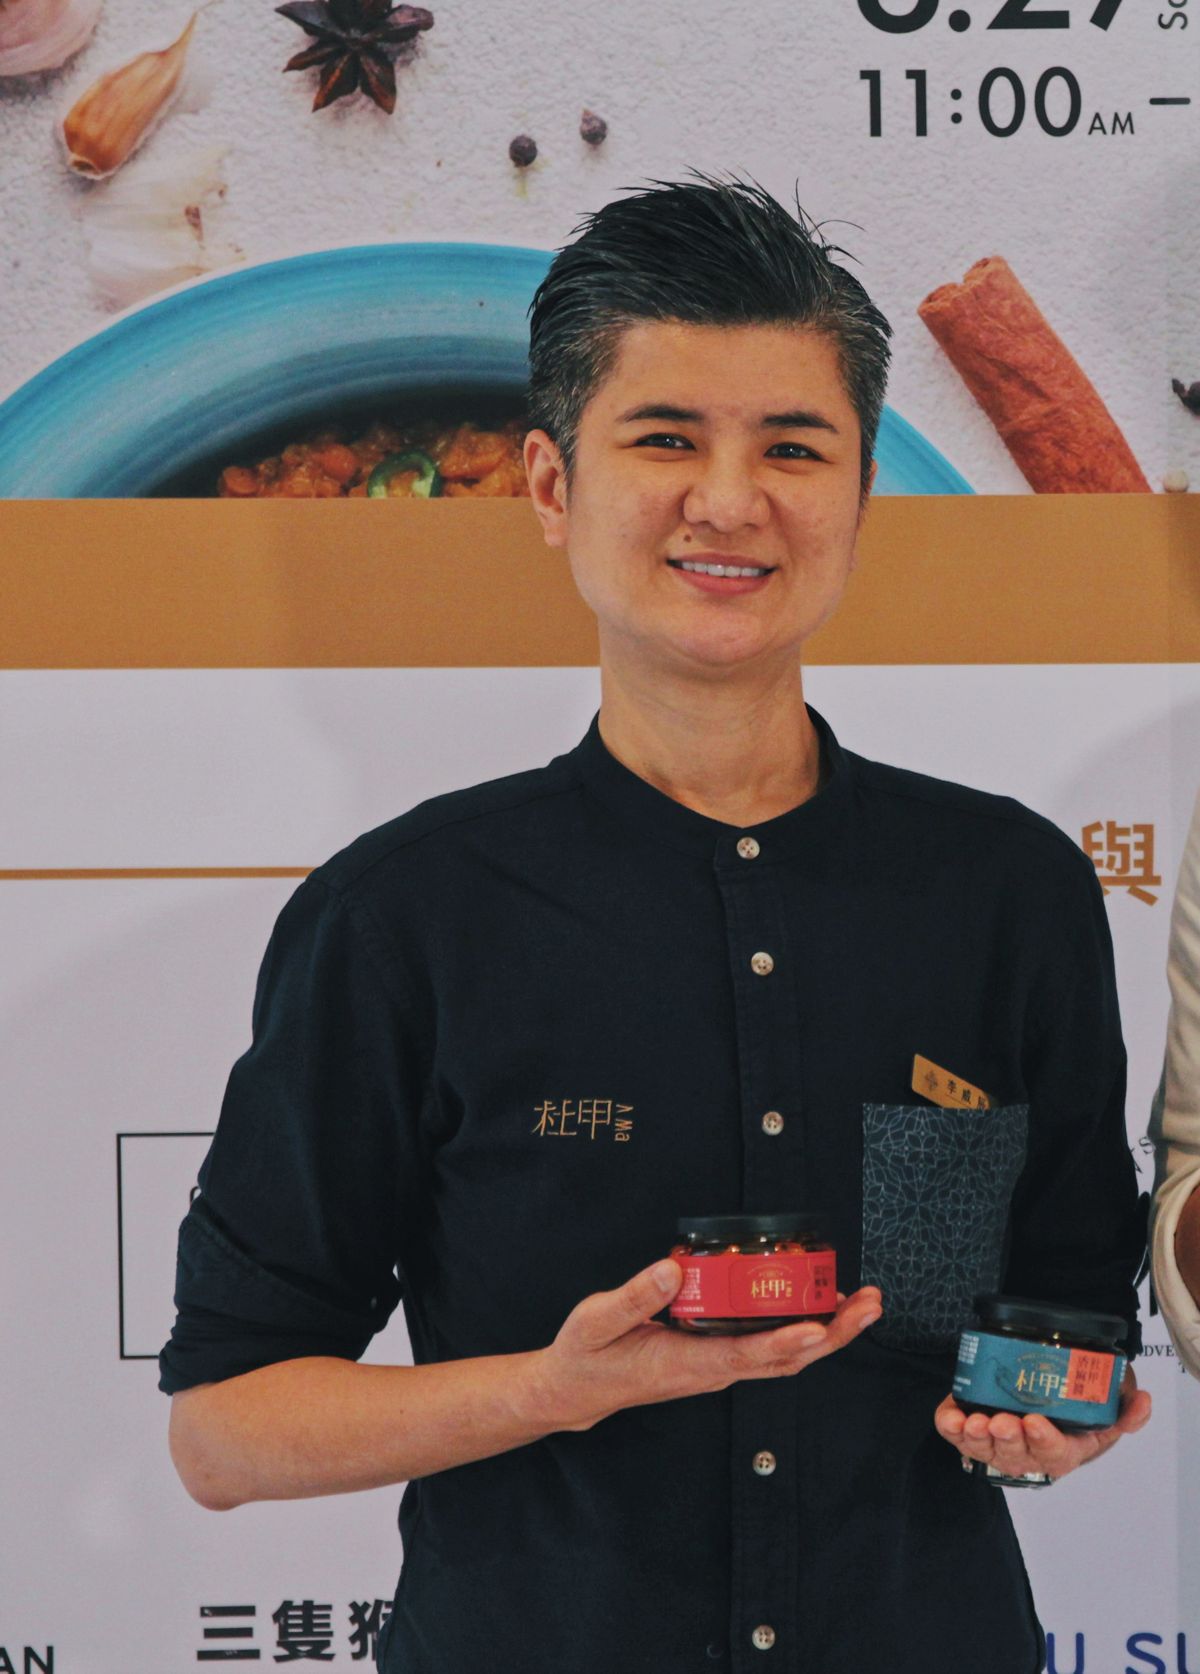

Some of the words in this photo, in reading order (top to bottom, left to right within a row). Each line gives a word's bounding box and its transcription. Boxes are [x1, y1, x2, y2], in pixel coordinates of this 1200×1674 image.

[859, 66, 1082, 138] 11:00
[1087, 111, 1135, 136] AM
[1081, 820, 1162, 907] 與
